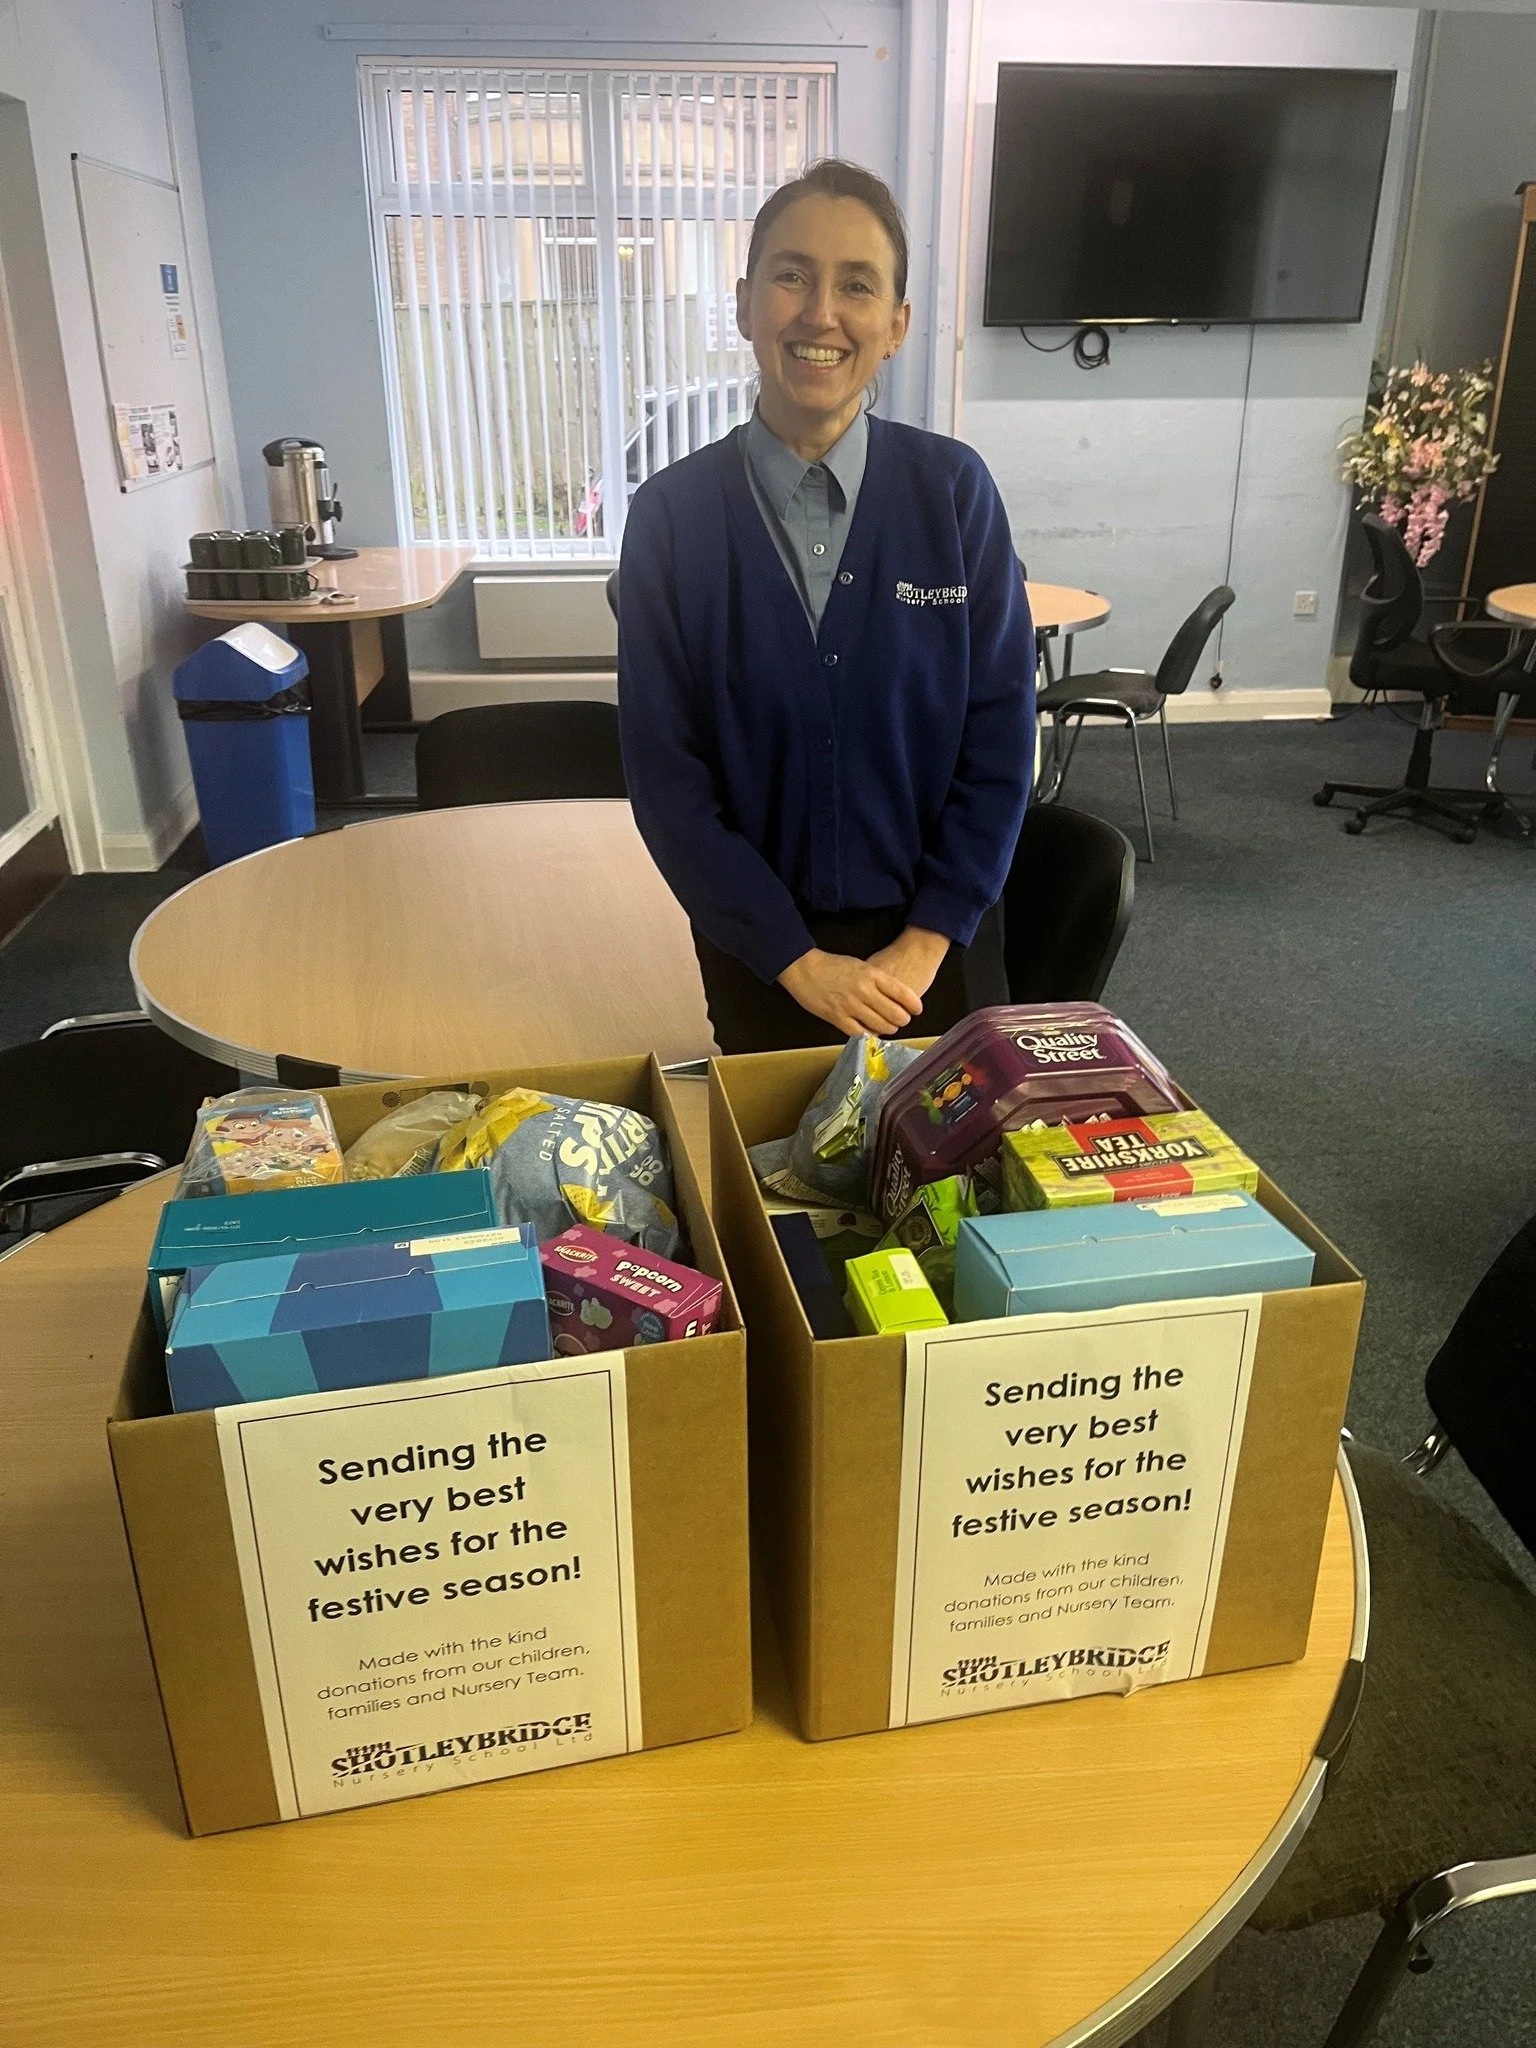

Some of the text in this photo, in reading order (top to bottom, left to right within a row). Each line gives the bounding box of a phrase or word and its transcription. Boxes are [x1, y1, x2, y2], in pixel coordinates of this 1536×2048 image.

[932, 597, 965, 606] School
[1016, 1032, 1098, 1051] Quality
[1033, 1048, 1107, 1064] Street
[539, 1107, 571, 1161] SALTED
[1095, 1134, 1145, 1151] TEA
[1061, 1140, 1203, 1172] YORKSHIRE
[554, 1245, 598, 1262] SNACKRITE
[610, 1274, 662, 1298] SWEET
[615, 1260, 683, 1293] Popcorn
[984, 1365, 1184, 1407] Sending the
[1005, 1409, 1159, 1448] very best
[318, 1432, 547, 1484] Sending the
[966, 1451, 1187, 1494] wishes for the
[351, 1476, 526, 1525] very best
[952, 1489, 1192, 1538] festive season!
[314, 1519, 568, 1576] wishes for the
[308, 1556, 582, 1622] festive season!
[984, 1552, 1150, 1588] Made with the kind
[944, 1572, 1184, 1613] donations from our children,
[950, 1596, 1176, 1633] families and Nursery Team.
[359, 1627, 547, 1671] Made with the kind
[942, 1640, 1171, 1687] SHOTLEYBRIDGE
[317, 1642, 590, 1700] donations from our children,
[940, 1678, 1031, 1698] Nursery
[1045, 1666, 1124, 1681] School
[327, 1665, 585, 1720] families and Nursery Team.
[330, 1713, 592, 1778] SHOTLEYBRIDGE
[333, 1762, 434, 1789] Nursery
[453, 1742, 538, 1765] School
